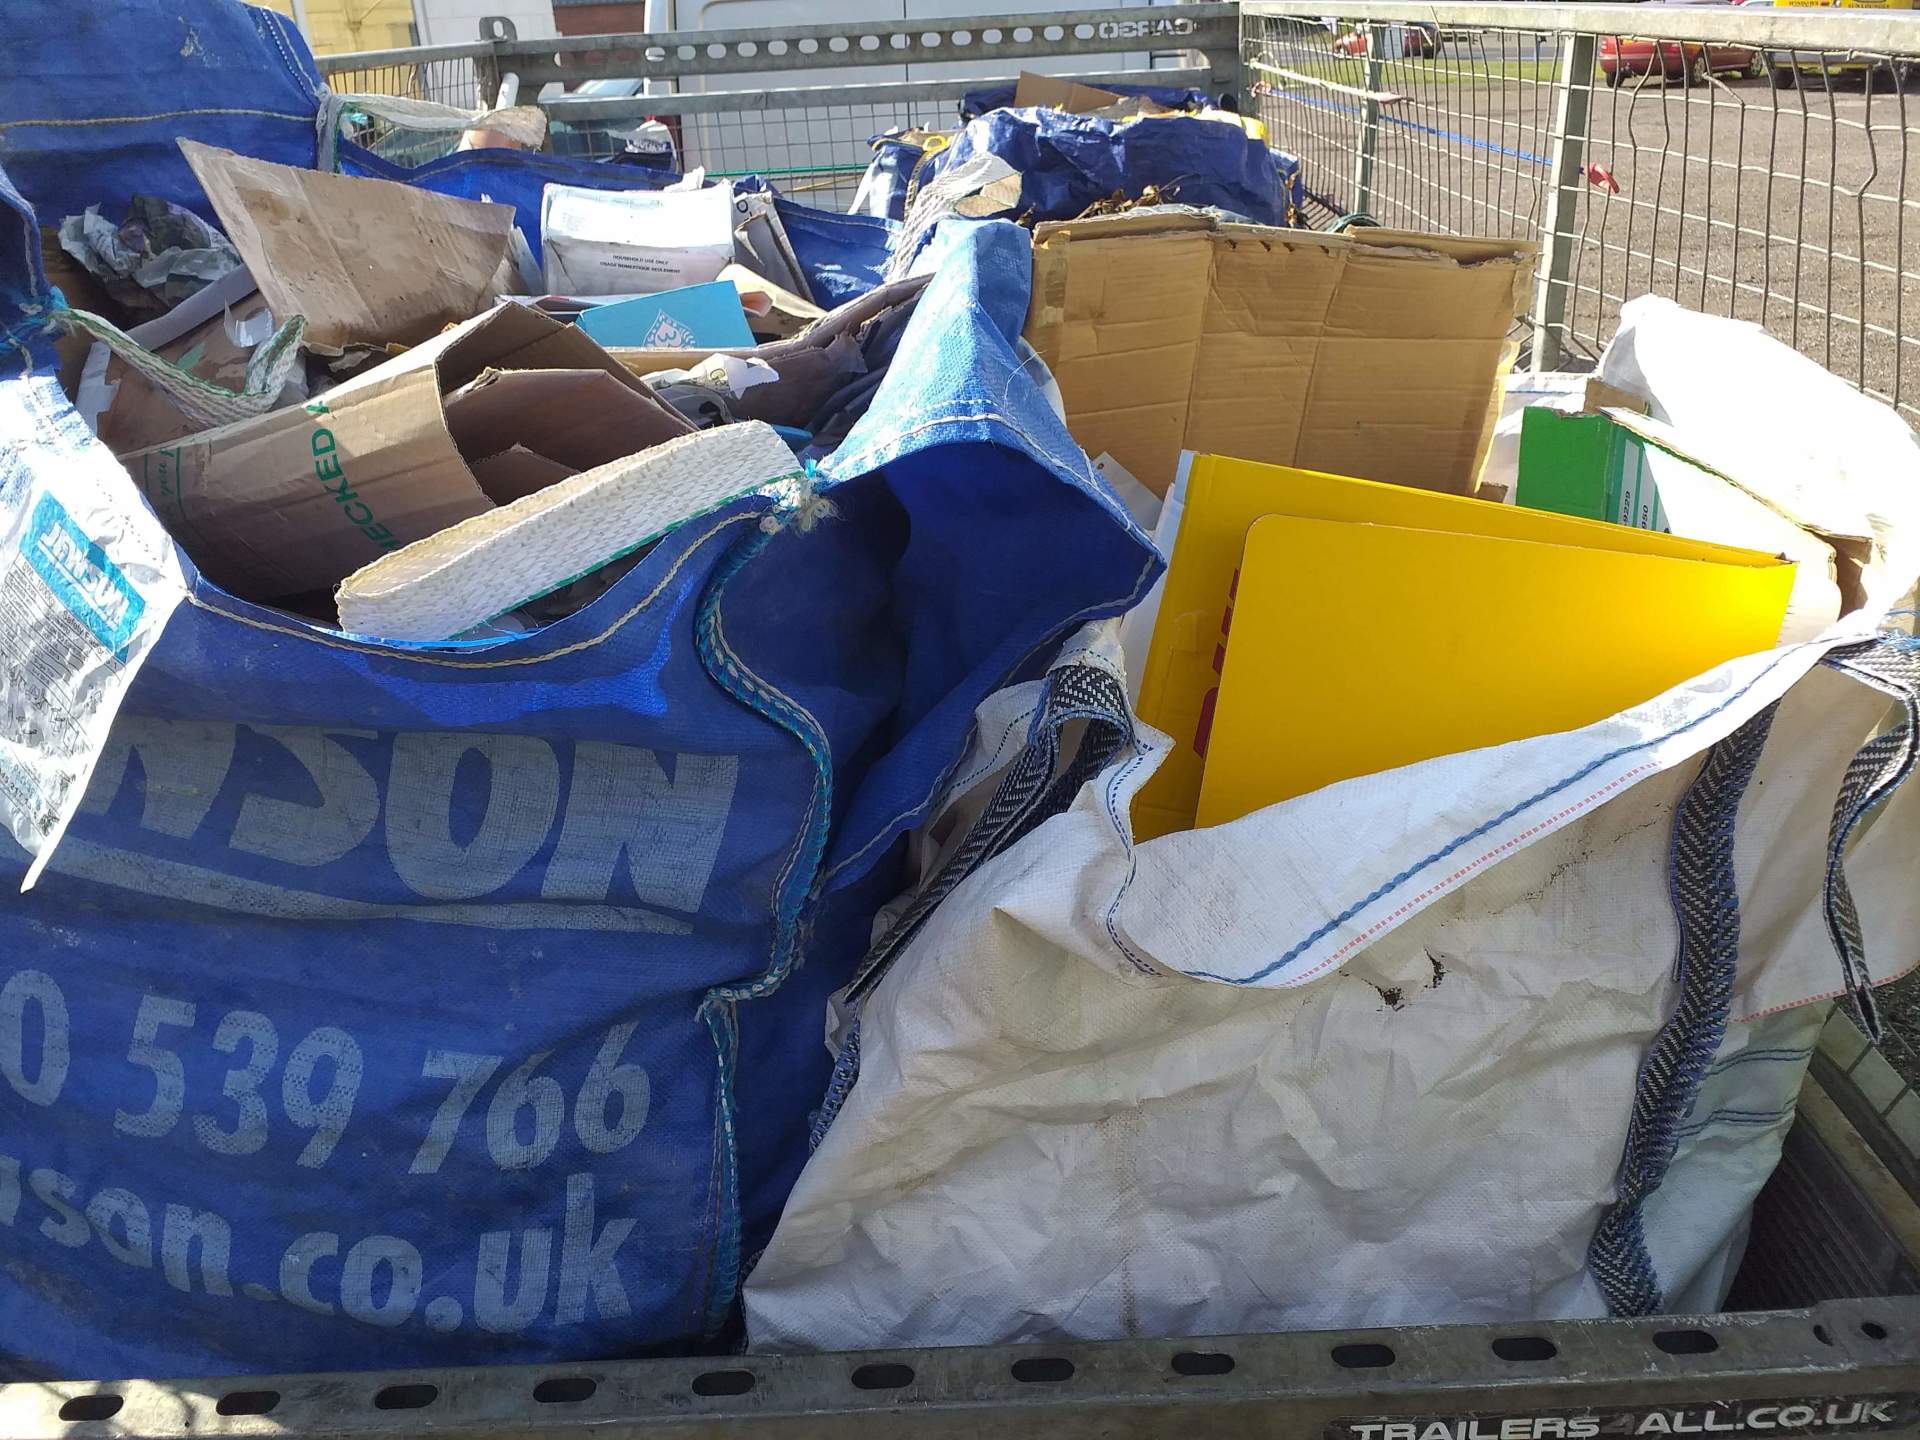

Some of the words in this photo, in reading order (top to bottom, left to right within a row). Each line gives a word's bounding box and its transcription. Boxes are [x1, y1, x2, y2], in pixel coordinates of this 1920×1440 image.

[62, 609, 86, 638] Safety
[113, 994, 364, 1170] 539
[407, 1020, 652, 1176] 766
